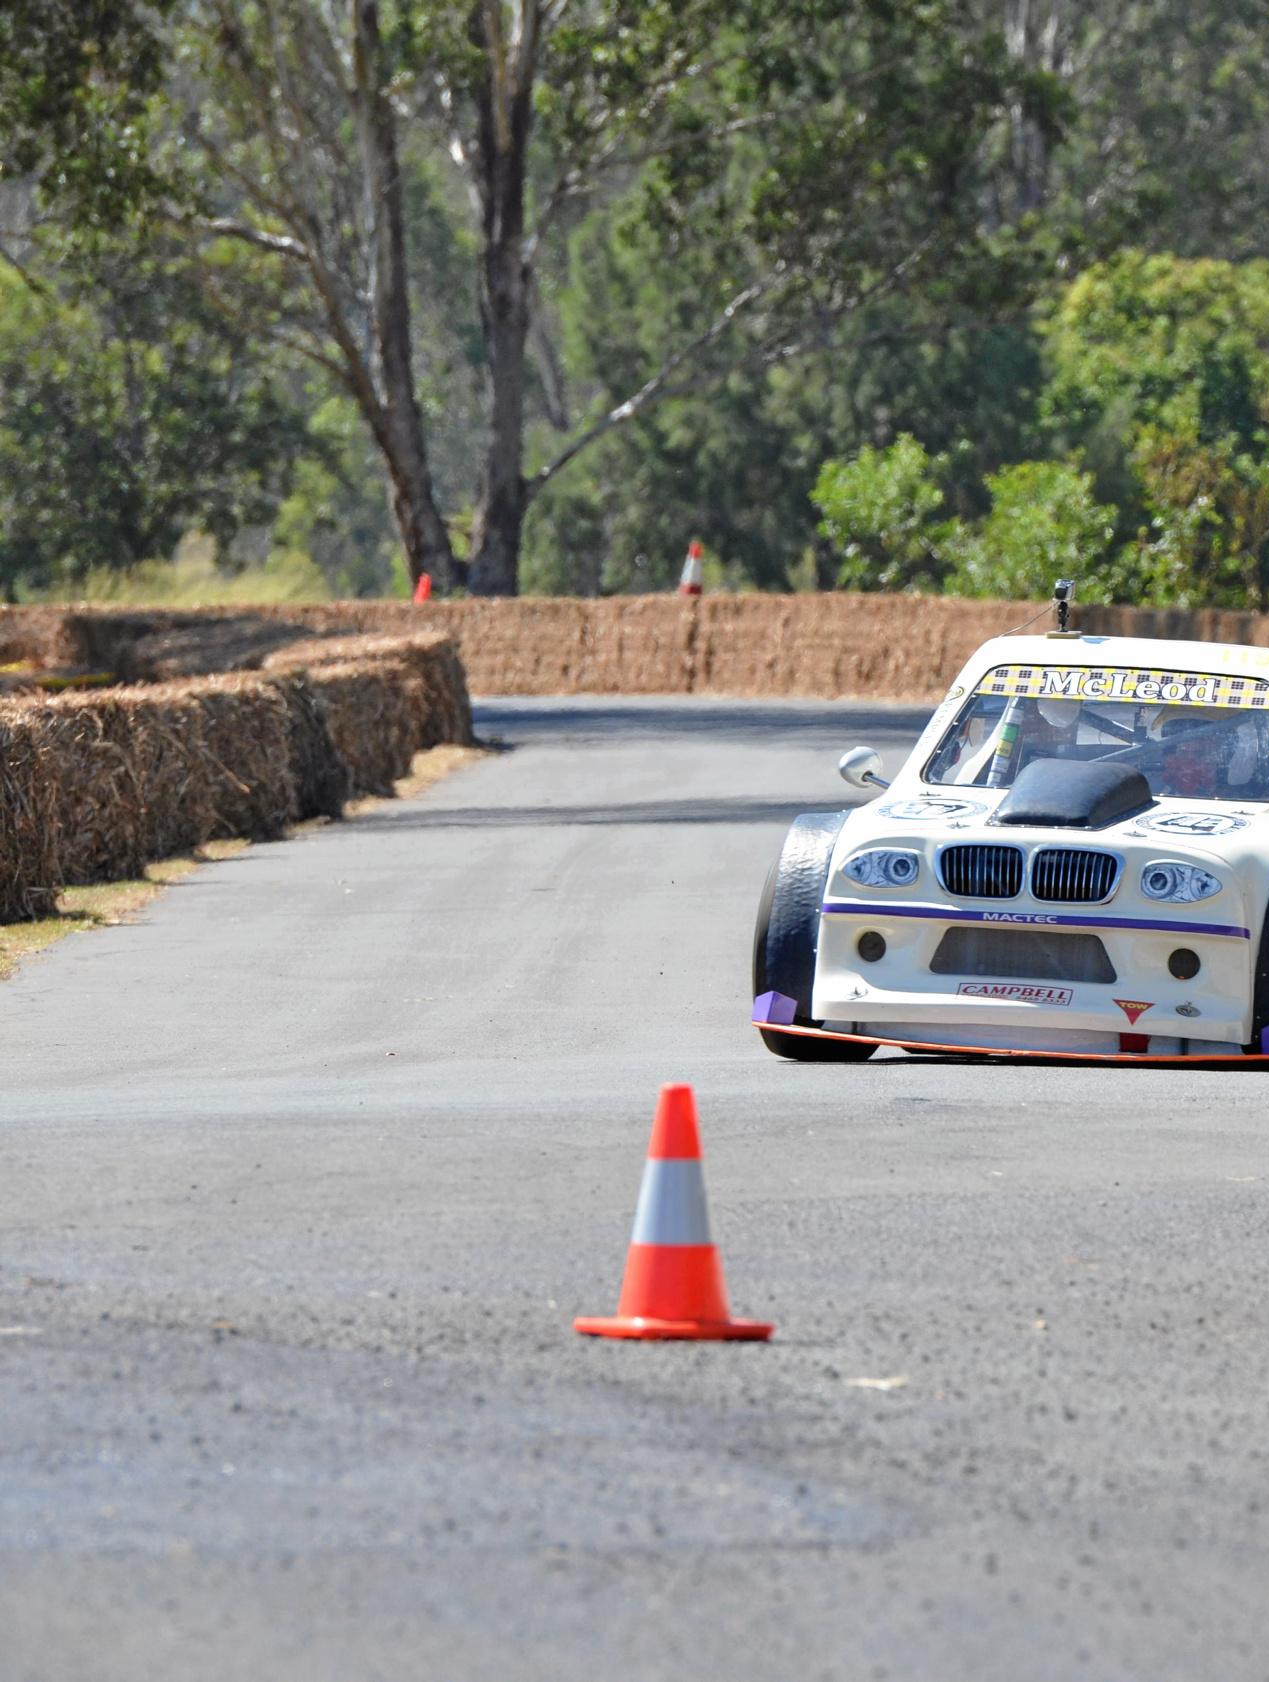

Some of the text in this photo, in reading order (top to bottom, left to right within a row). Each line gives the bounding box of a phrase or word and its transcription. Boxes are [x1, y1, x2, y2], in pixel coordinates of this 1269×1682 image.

[1040, 670, 1217, 703] McLeod
[983, 912, 1057, 924] MACTEC
[962, 985, 1067, 1000] CAMPBELL
[1119, 1001, 1149, 1010] TOW
